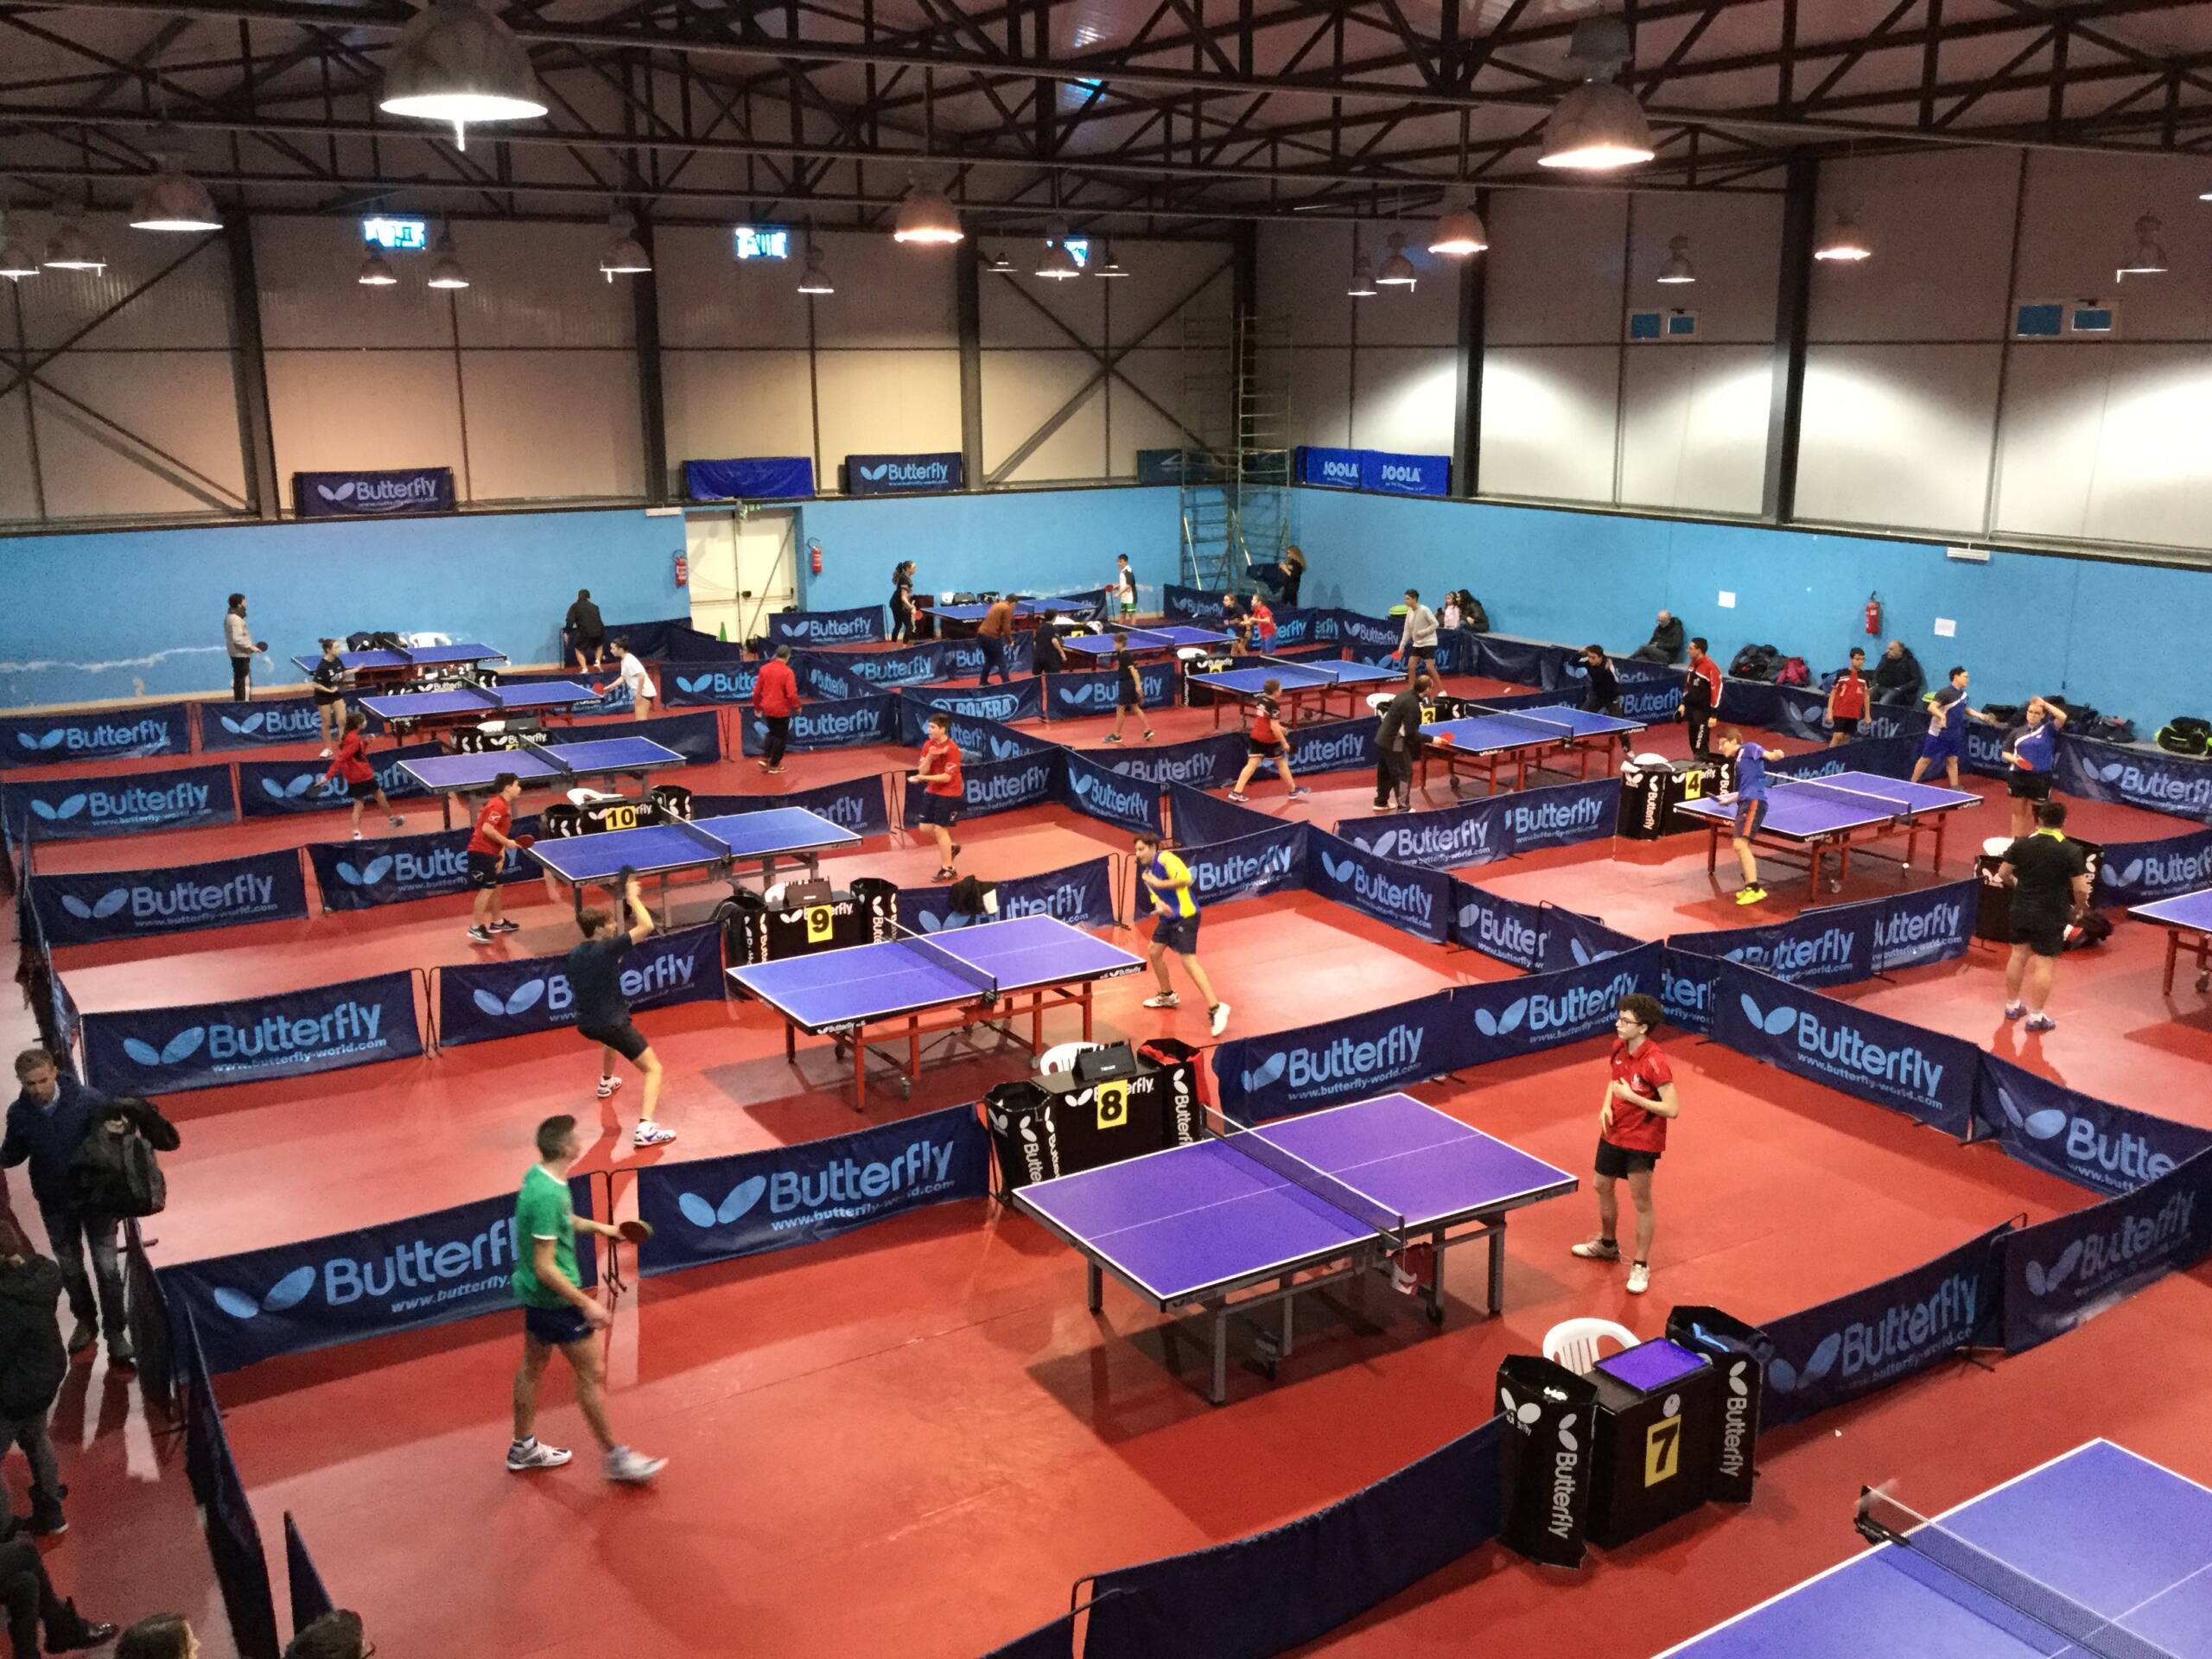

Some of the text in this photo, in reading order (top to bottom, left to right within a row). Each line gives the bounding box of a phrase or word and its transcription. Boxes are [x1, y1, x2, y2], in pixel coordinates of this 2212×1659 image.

[356, 477, 436, 500] Butterfly
[888, 462, 948, 480] Butterfly
[1323, 461, 1358, 478] JOOLA
[1382, 465, 1421, 483] JOOLA
[810, 617, 871, 637] Butterfly
[715, 674, 756, 692] Butte
[865, 656, 931, 680] Butterfly
[67, 720, 167, 749] Butterfly
[795, 709, 879, 737] Butterfly
[1424, 710, 1434, 724] 3
[89, 783, 208, 817] Butterfly
[967, 766, 1050, 804] Butterfly
[1090, 779, 1148, 822] Butterfly
[1688, 773, 1700, 791] 4
[607, 808, 634, 828] 10
[1516, 798, 1603, 834] Butterfly
[1397, 820, 1488, 856] Butterfly
[395, 847, 519, 881] Buttey
[1198, 844, 1292, 891] Butterfly
[132, 874, 273, 917] Butterfly
[1355, 862, 1433, 922] Butterfly
[810, 909, 830, 933] 9
[1480, 910, 1551, 957] Butter
[548, 953, 694, 1010] Berfly
[1529, 972, 1639, 1033] Butterfly
[209, 1002, 382, 1059] Butterfly
[1287, 1023, 1424, 1088] Butterfly
[1797, 1011, 1942, 1098] Butterfly
[1797, 1051, 1943, 1111] www.butterfly-world.com
[1100, 1090, 1122, 1122] 8
[2066, 1116, 2176, 1180] Butte
[770, 1140, 954, 1213] Butterfly
[772, 1179, 955, 1231] www.butterfly-wod.com
[324, 1217, 518, 1306] Butterfl
[1842, 1273, 1979, 1376] Butterfly
[1652, 1422, 1679, 1474] 7
[1719, 1397, 1747, 1478] Butterfly
[1548, 1451, 1578, 1540] Butterfly
